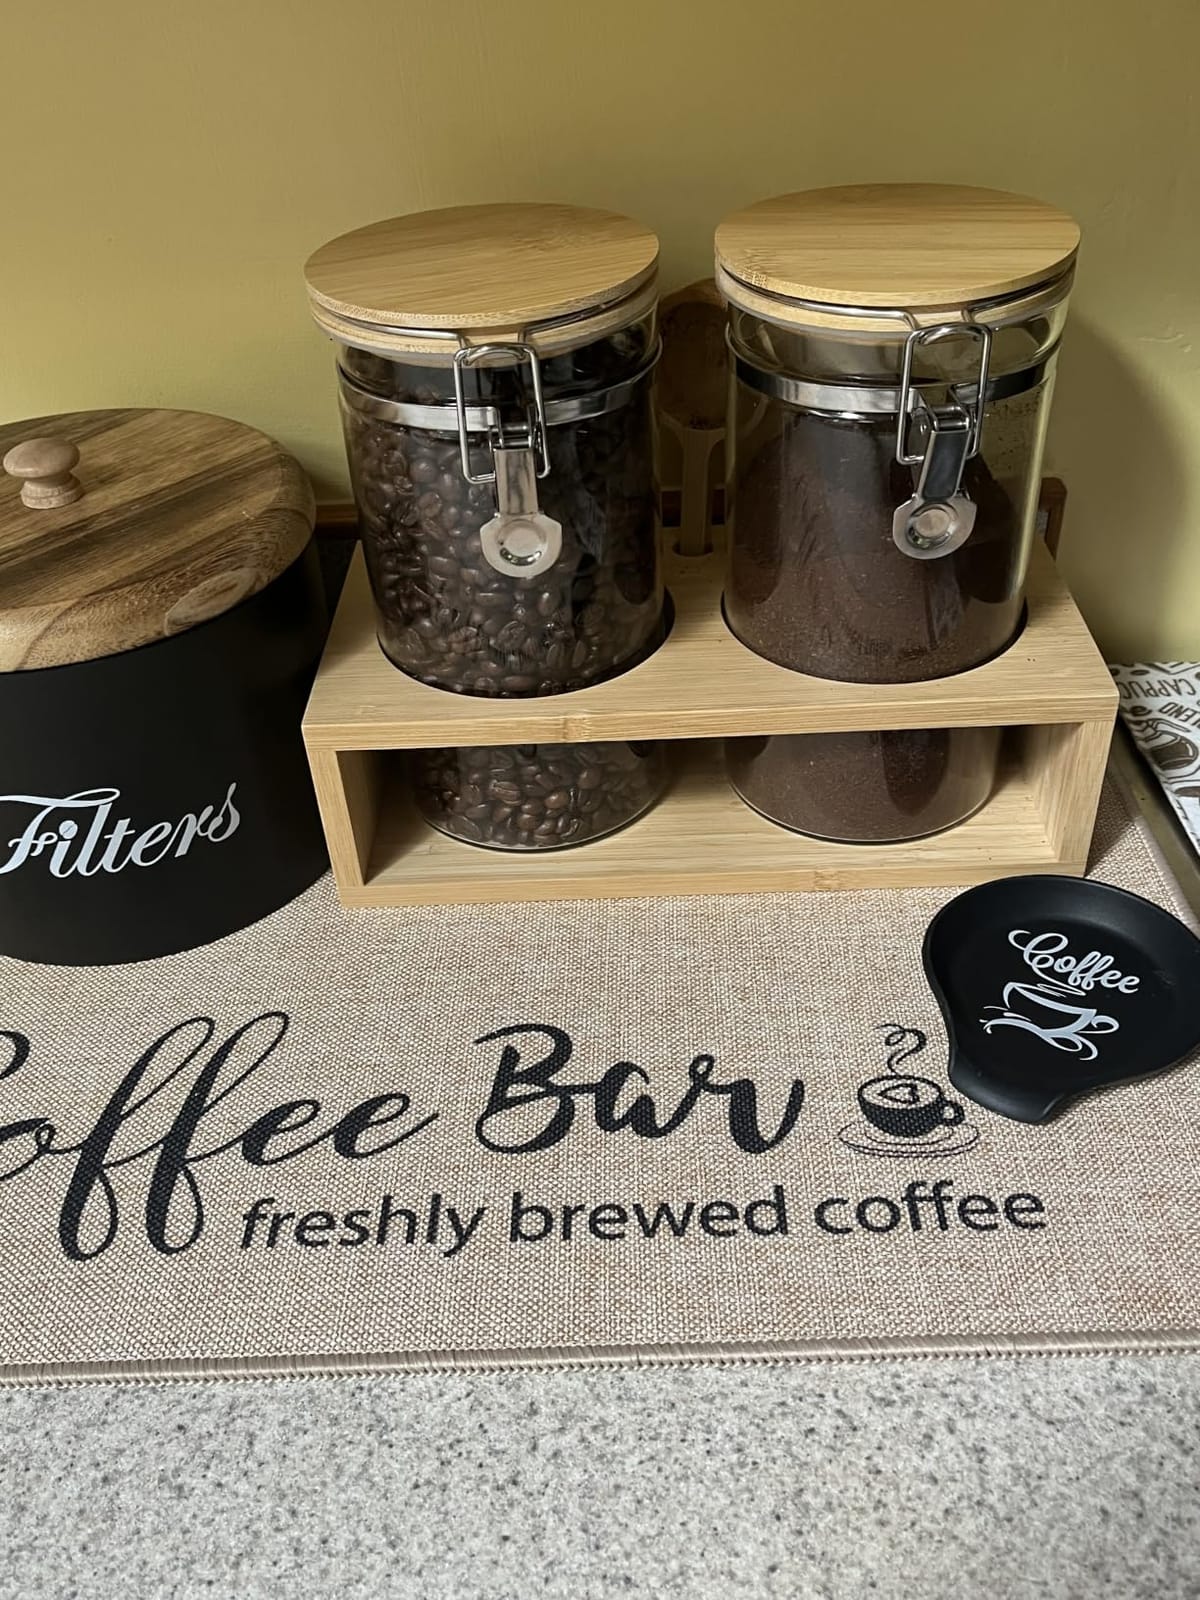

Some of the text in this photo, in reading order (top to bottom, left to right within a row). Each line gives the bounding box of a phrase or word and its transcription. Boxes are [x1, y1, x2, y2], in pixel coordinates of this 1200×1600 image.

[1159, 702, 1200, 729] LEND
[0, 781, 241, 878] Filters
[1008, 929, 1140, 996] Coffee
[474, 1023, 805, 1154] Bar
[241, 1179, 1046, 1258] freshly brewed coffee
